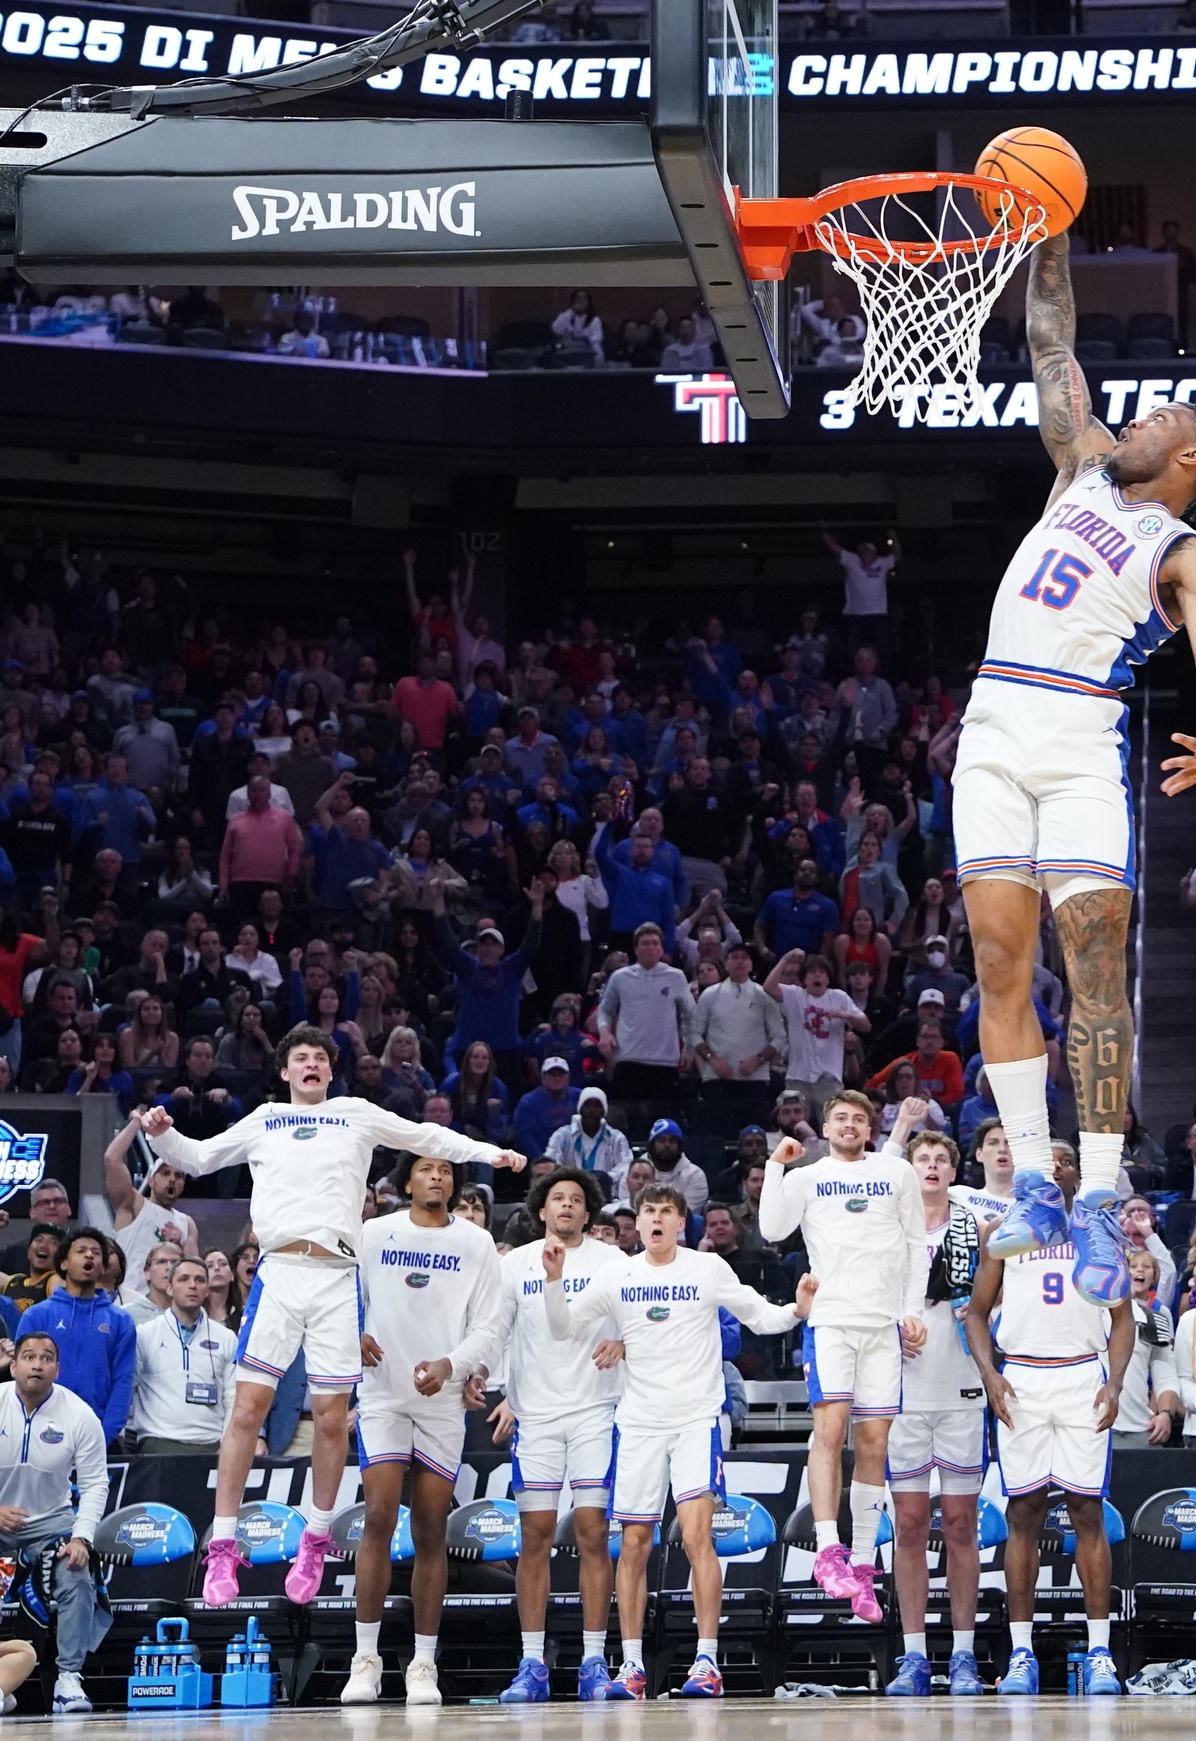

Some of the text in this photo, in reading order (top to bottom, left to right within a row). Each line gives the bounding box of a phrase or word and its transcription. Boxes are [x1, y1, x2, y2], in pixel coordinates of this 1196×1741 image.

[0, 12, 125, 63] 025
[139, 25, 214, 71] DI
[231, 181, 477, 241] SPALDING
[820, 389, 857, 429] 3
[894, 383, 1039, 429] TEXA
[459, 531, 501, 552] 102
[1044, 503, 1138, 577] FLORIDA
[1019, 548, 1095, 611] 15
[816, 1180, 893, 1198] NOTHING EASY.
[967, 1195, 1008, 1214] NOTHING
[381, 1249, 461, 1272] NOTHING EASY.
[523, 1278, 570, 1295] NOTG
[621, 1285, 700, 1303] NOTHING EASY.
[1043, 1272, 1065, 1305] 9
[129, 1522, 155, 1532] MARCH
[244, 1520, 271, 1530] MARCH
[478, 1516, 504, 1526] MARCH
[480, 1523, 514, 1534] MADNESS
[131, 1529, 165, 1539] MADNESS
[247, 1527, 282, 1538] MADNESS
[118, 1604, 132, 1612] FINAL
[133, 1604, 148, 1612] FOUR
[194, 1602, 204, 1610] THE
[253, 1601, 268, 1609] FOUR
[318, 1601, 328, 1609] THE
[329, 1601, 343, 1609] ROAD
[343, 1601, 351, 1609] TO
[481, 1598, 496, 1606] FINAL
[497, 1598, 511, 1606] FOUR
[132, 1686, 174, 1696] POWERADE
